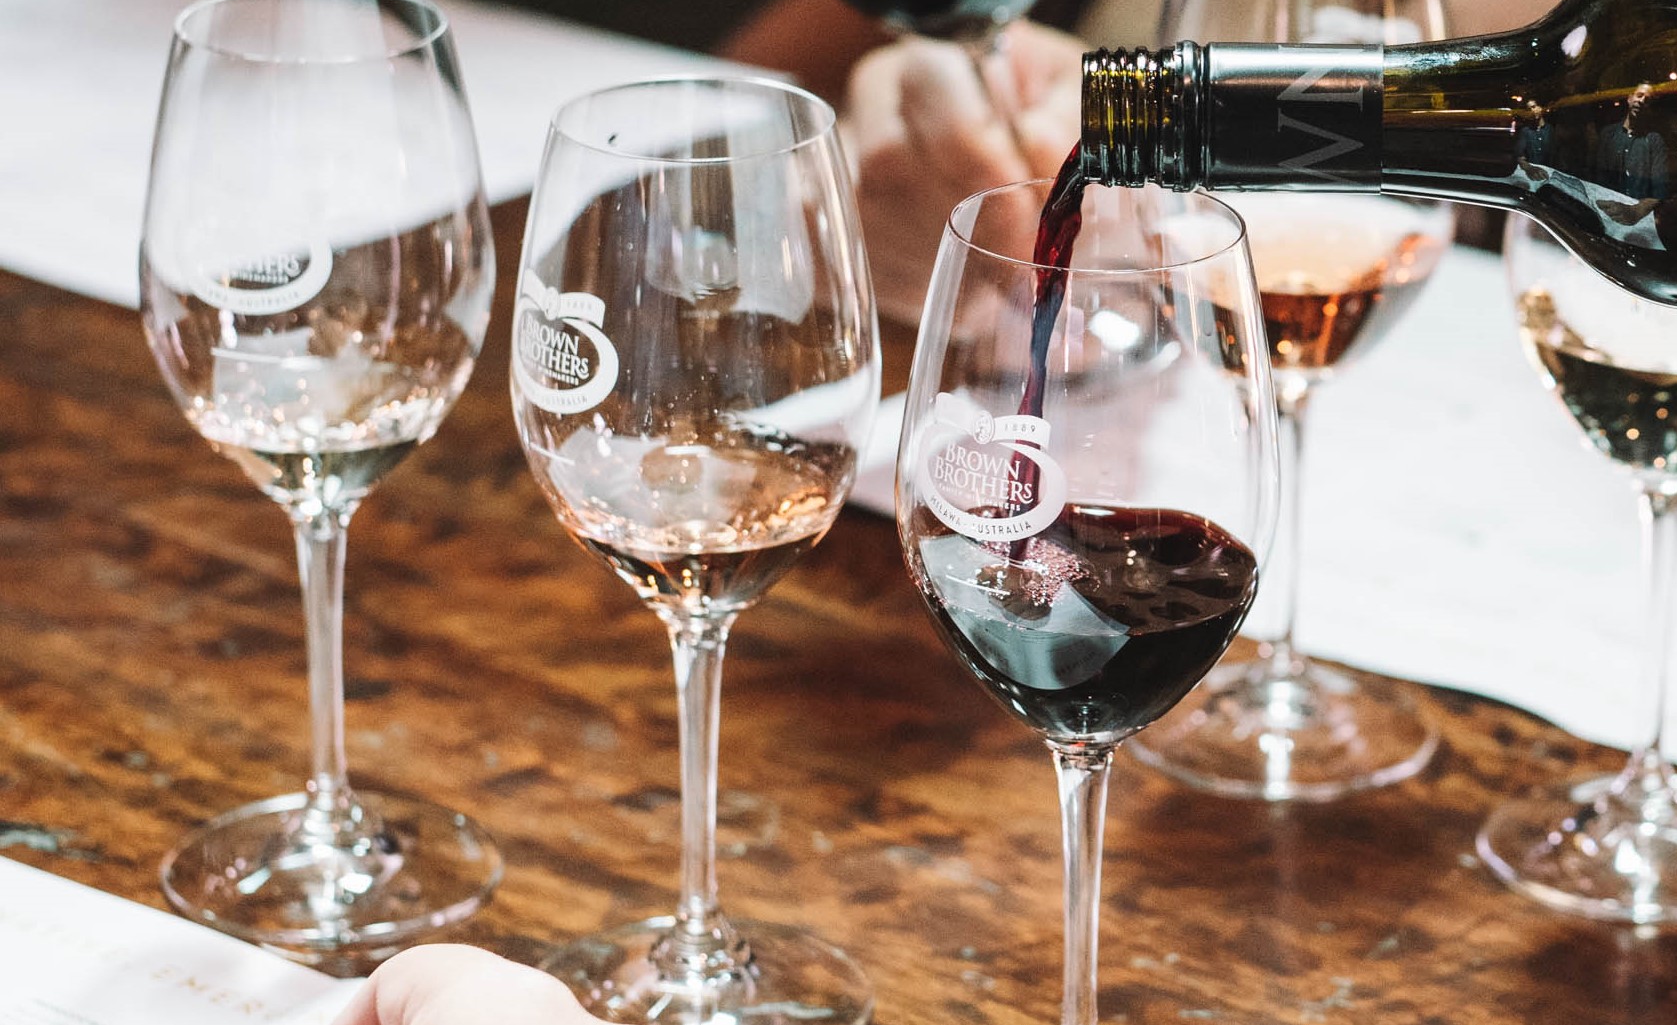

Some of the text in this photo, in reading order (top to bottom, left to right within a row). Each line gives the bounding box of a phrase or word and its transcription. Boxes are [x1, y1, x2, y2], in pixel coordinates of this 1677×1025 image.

[526, 311, 579, 356] BROWN
[934, 456, 1034, 504] BROTHERS
[945, 440, 1021, 481] BROWN
[972, 521, 1032, 535] USTRALIA
